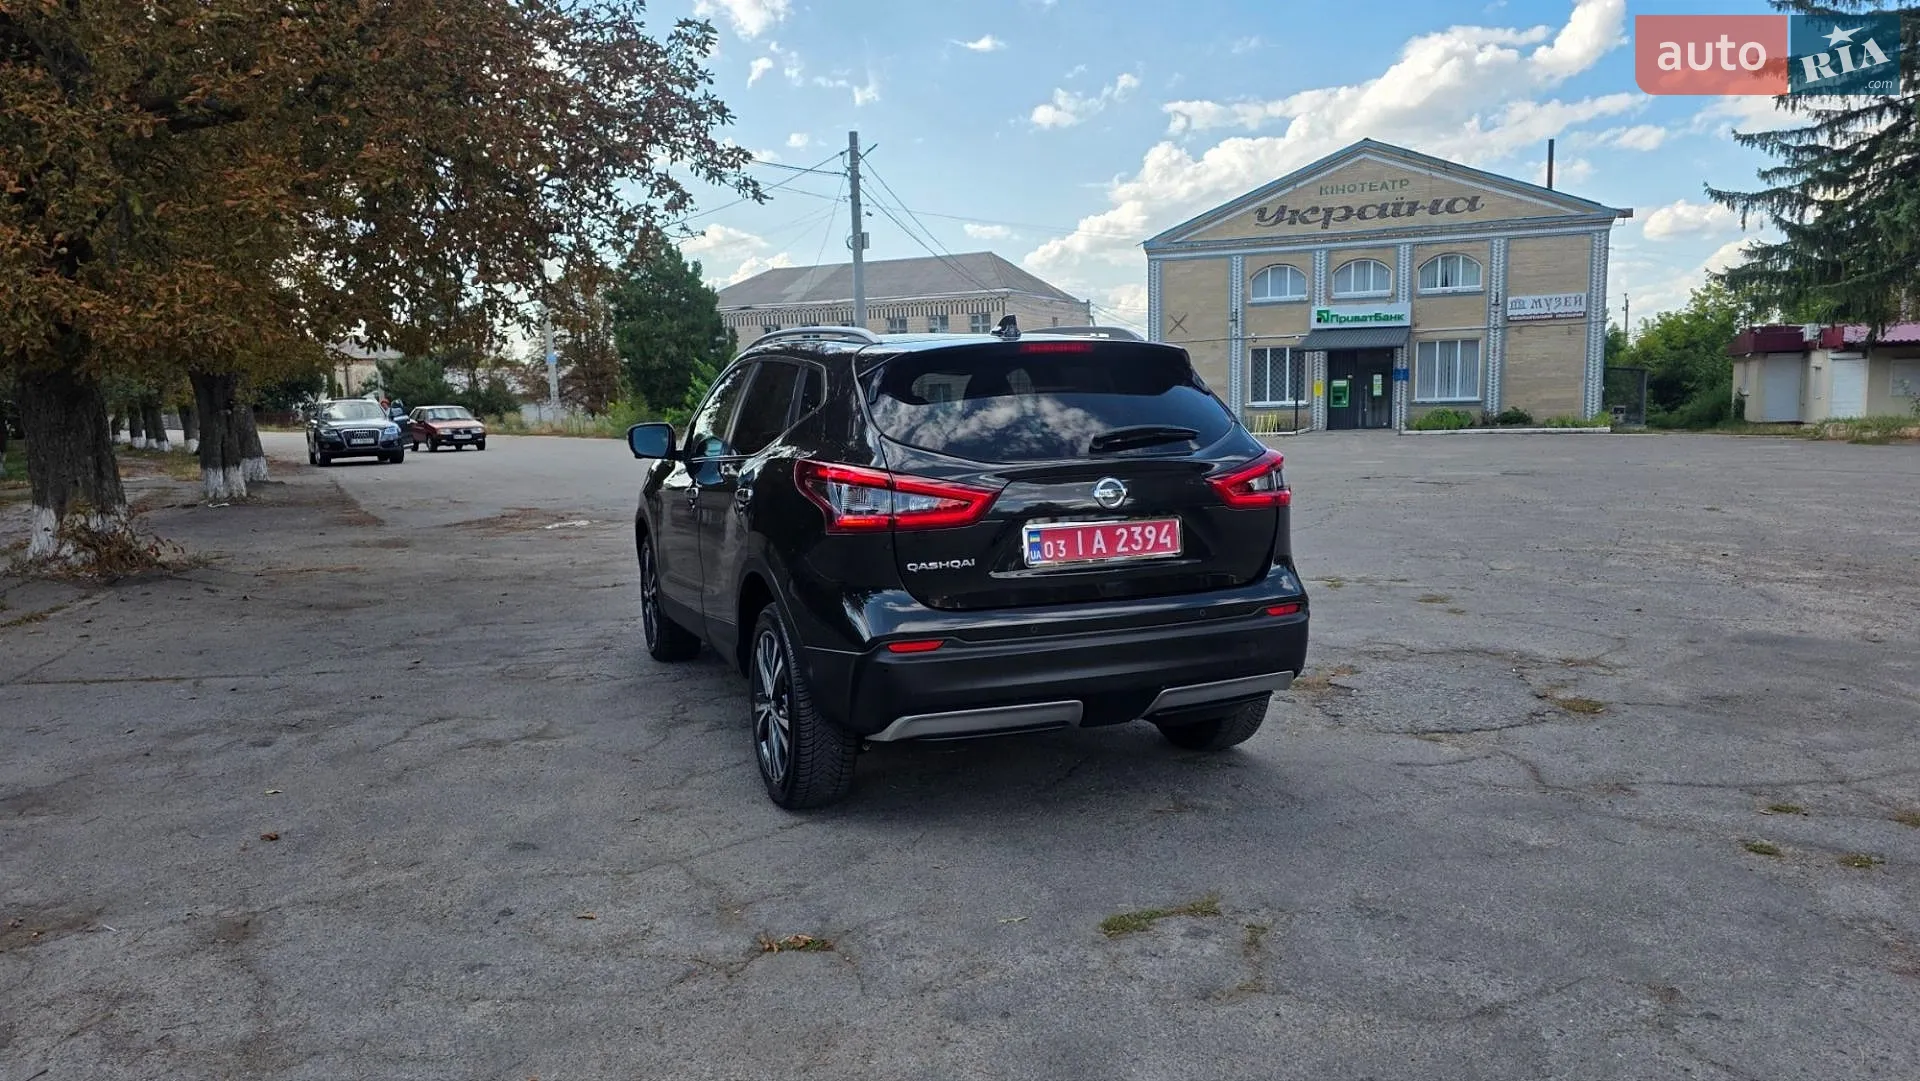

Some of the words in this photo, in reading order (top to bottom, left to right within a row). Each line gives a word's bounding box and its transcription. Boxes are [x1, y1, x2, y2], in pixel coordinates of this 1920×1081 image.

[1318, 178, 1410, 196] КІНОТЕАТР
[1530, 294, 1583, 311] МУЗЕЙ
[1329, 312, 1405, 324] ПриватБанк
[1043, 540, 1067, 559] 03
[1115, 524, 1172, 553] 2394
[1030, 550, 1042, 561] UA
[906, 558, 976, 573] QASHQAI
